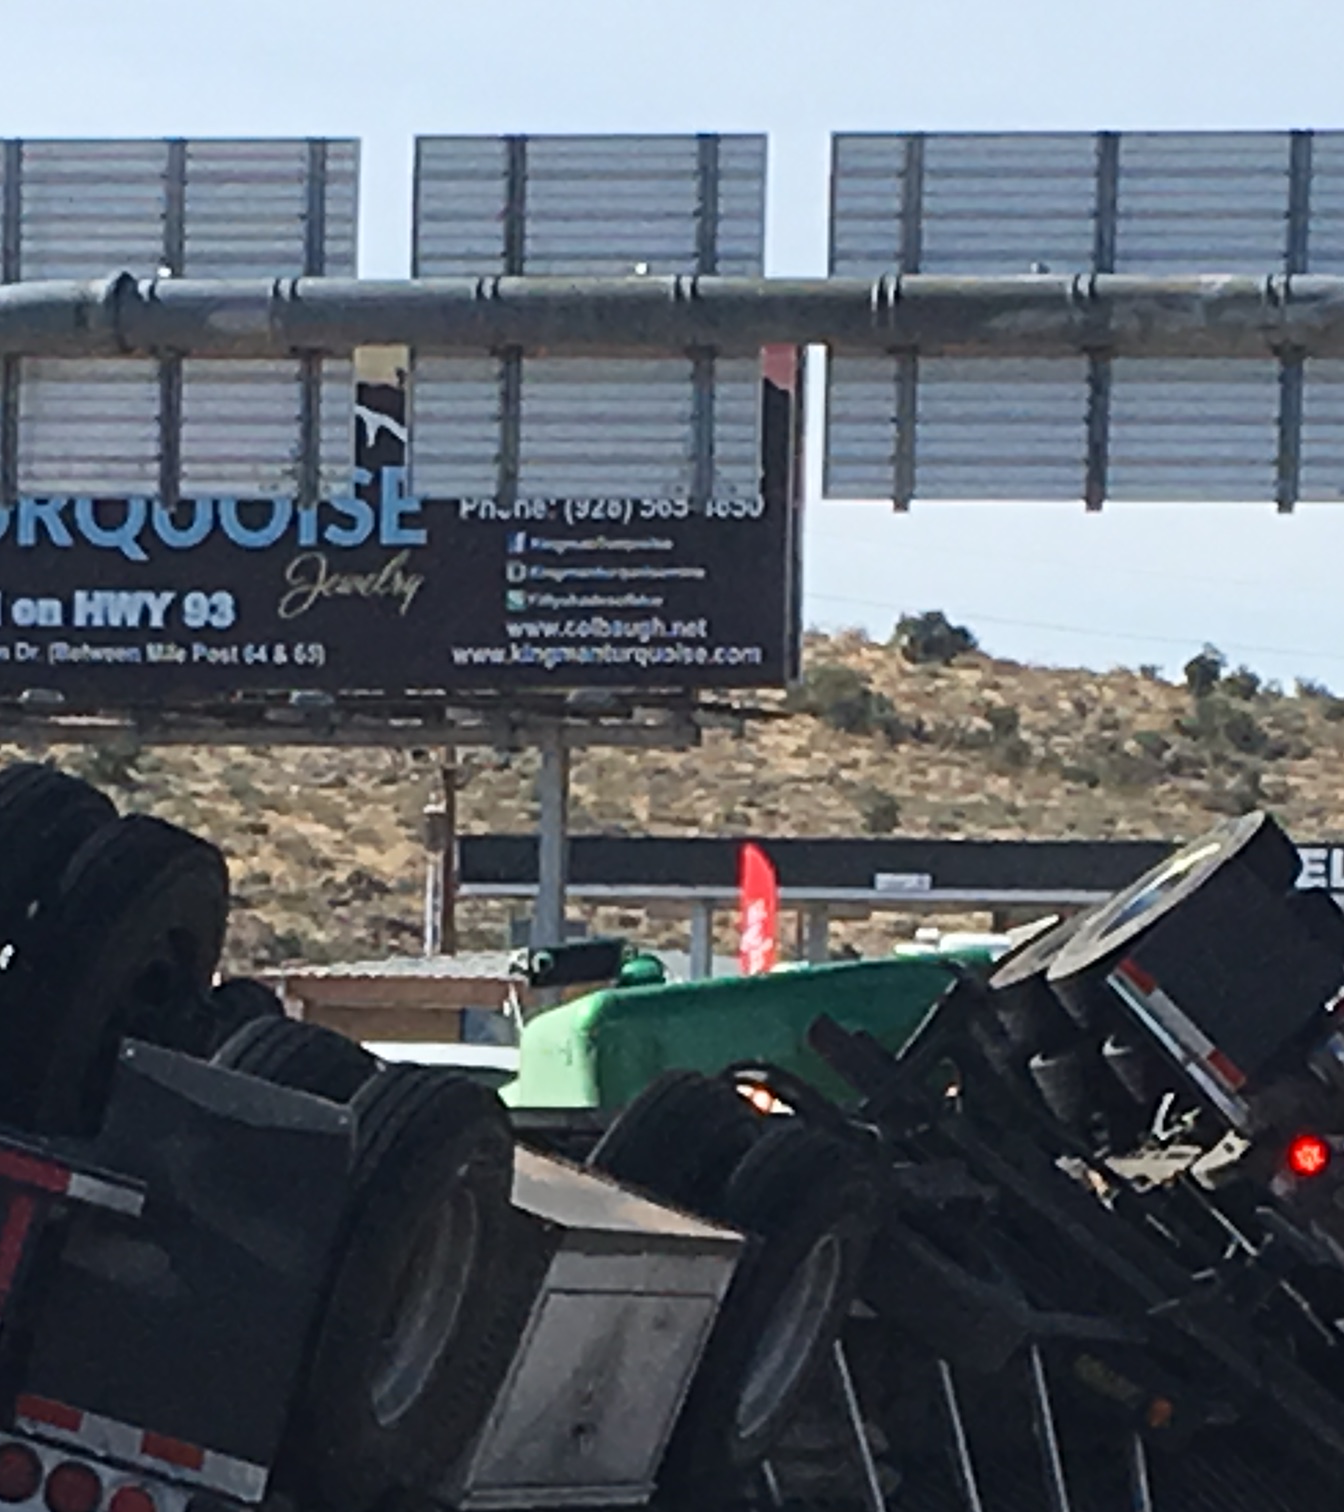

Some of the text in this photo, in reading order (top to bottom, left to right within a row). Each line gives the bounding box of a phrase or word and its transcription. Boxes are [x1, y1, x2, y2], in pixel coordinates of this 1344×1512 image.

[278, 551, 424, 617] Jewelry
[11, 598, 62, 627] on
[74, 589, 176, 628] HWY
[182, 590, 236, 629] 93
[506, 617, 707, 643] www.colbaugh.net
[192, 643, 238, 663] Post
[244, 642, 268, 662] 64
[272, 643, 288, 663] &
[453, 644, 763, 670] www.kingmanturquoise.com
